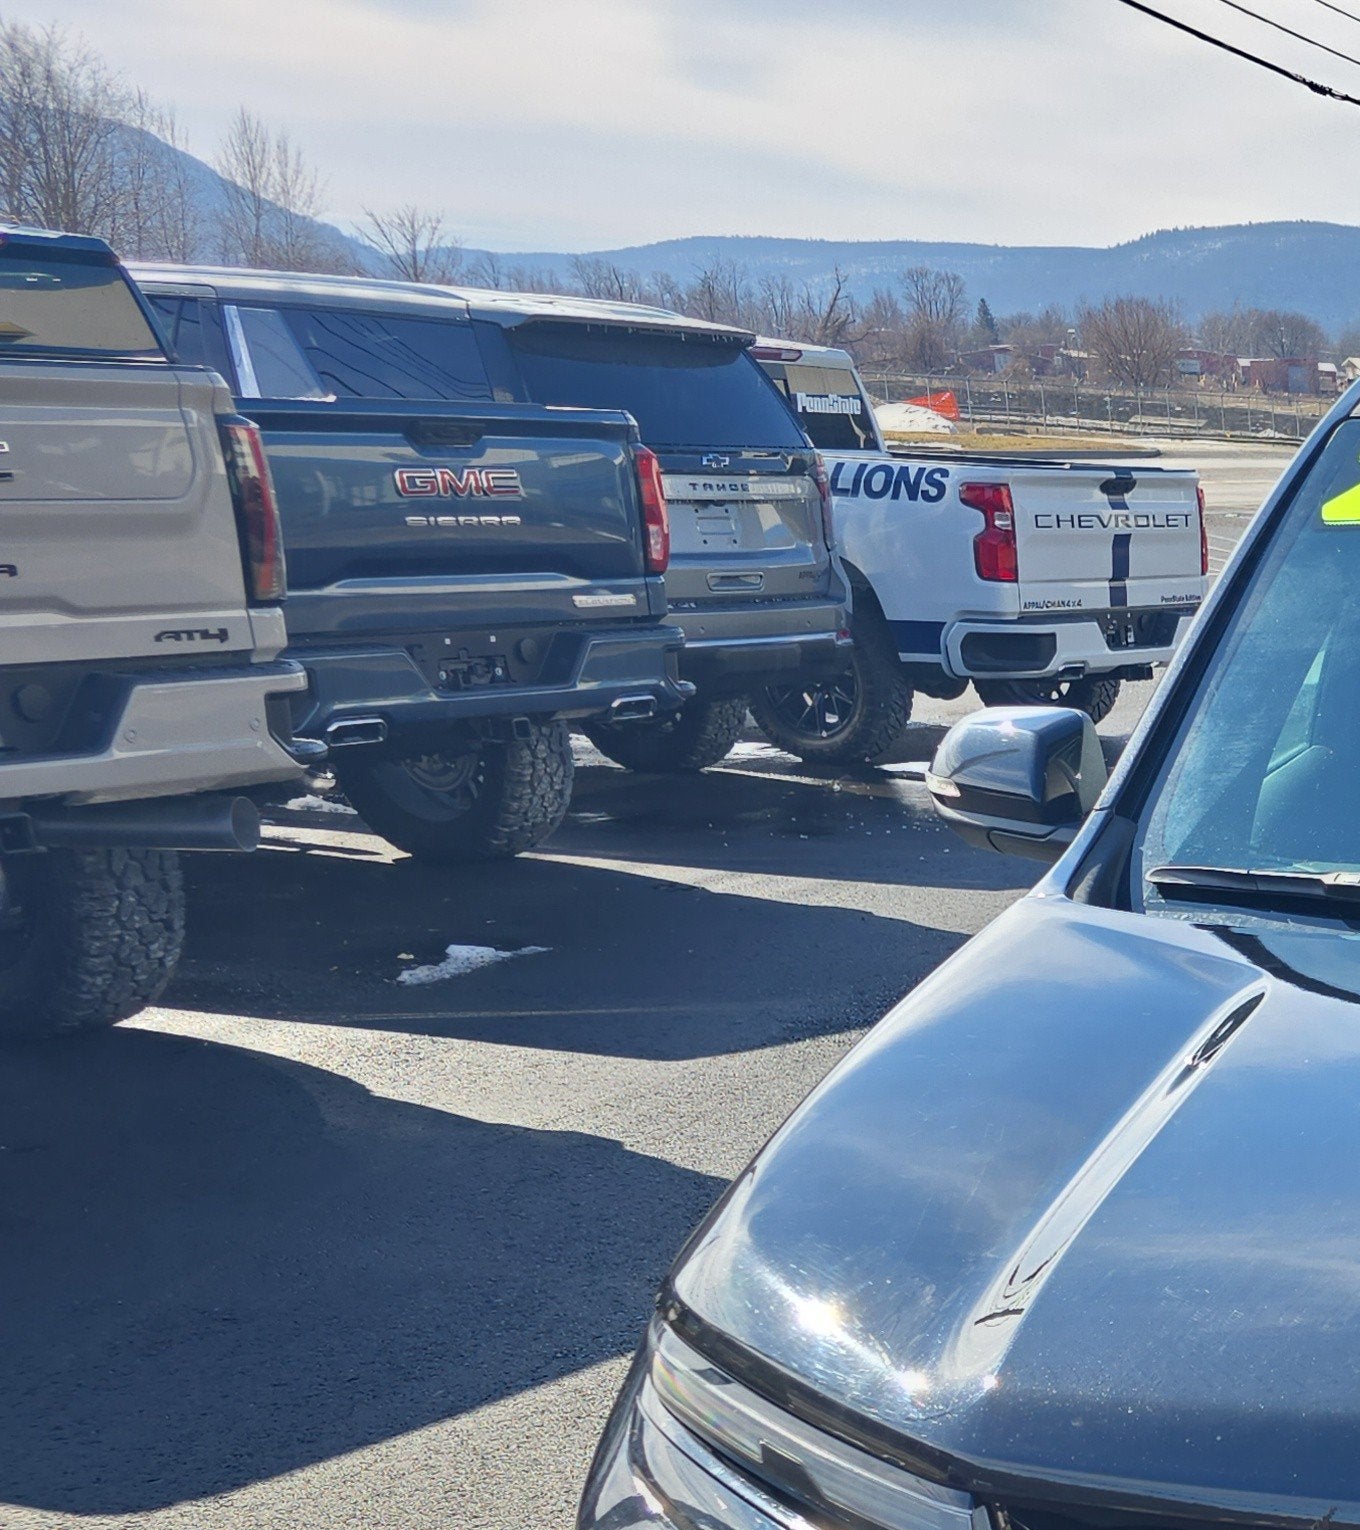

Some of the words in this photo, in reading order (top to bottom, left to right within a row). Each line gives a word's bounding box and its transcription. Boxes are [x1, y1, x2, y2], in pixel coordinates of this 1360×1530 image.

[393, 467, 521, 497] GMC
[689, 482, 750, 492] TAHOE
[830, 462, 949, 503] LIONS
[405, 516, 521, 526] SIERRA
[1034, 514, 1192, 529] CHEVROLET
[153, 628, 229, 643] AT4
